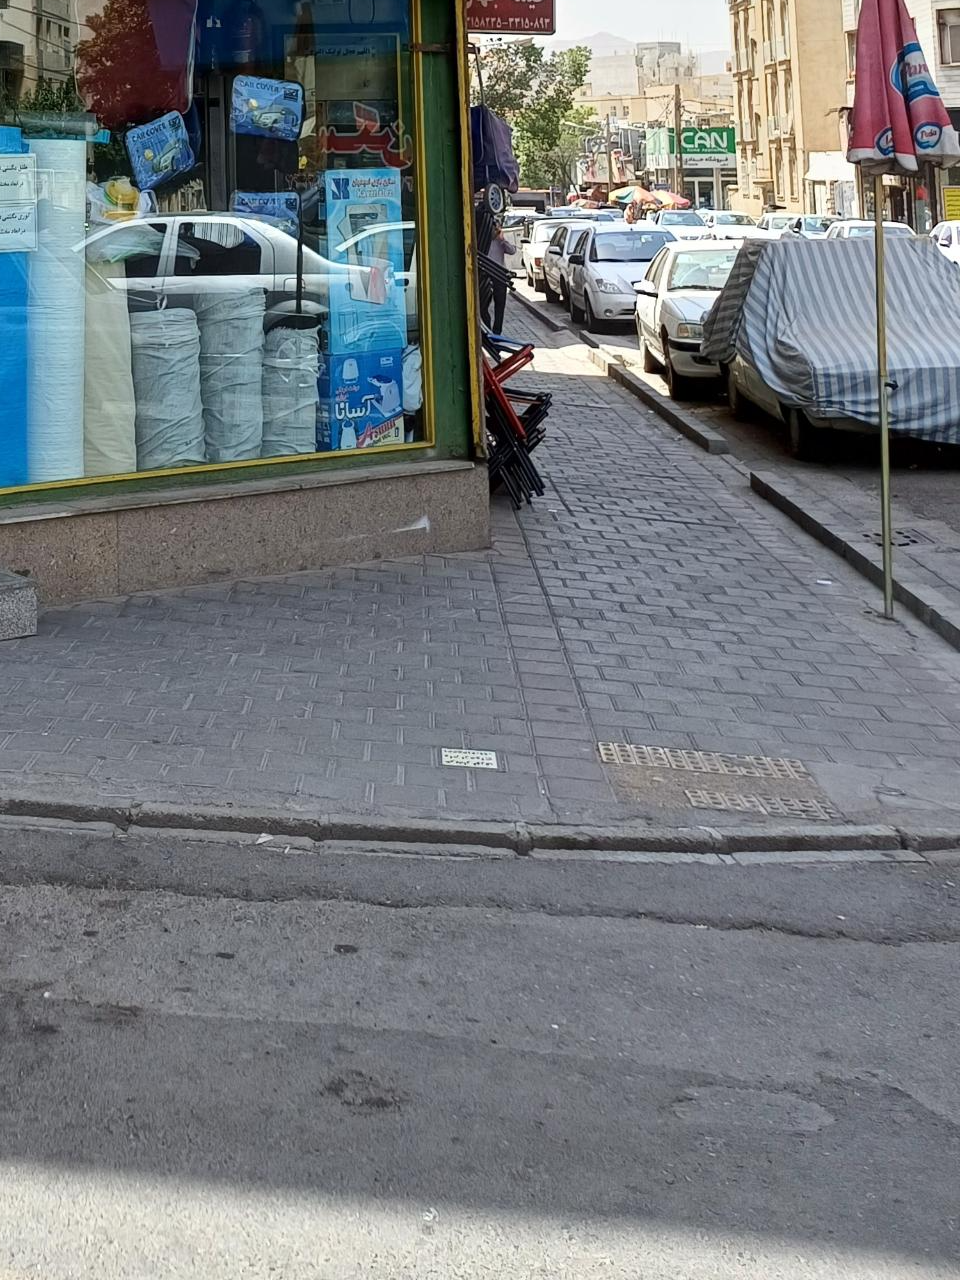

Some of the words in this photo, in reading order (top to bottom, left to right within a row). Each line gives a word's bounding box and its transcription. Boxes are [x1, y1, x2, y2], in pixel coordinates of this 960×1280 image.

[239, 80, 255, 89] CAR
[256, 82, 279, 94] COVER
[131, 130, 146, 143] CAR
[146, 122, 167, 137] COVER
[681, 131, 728, 149] CAN
[335, 395, 374, 419] آسانا
